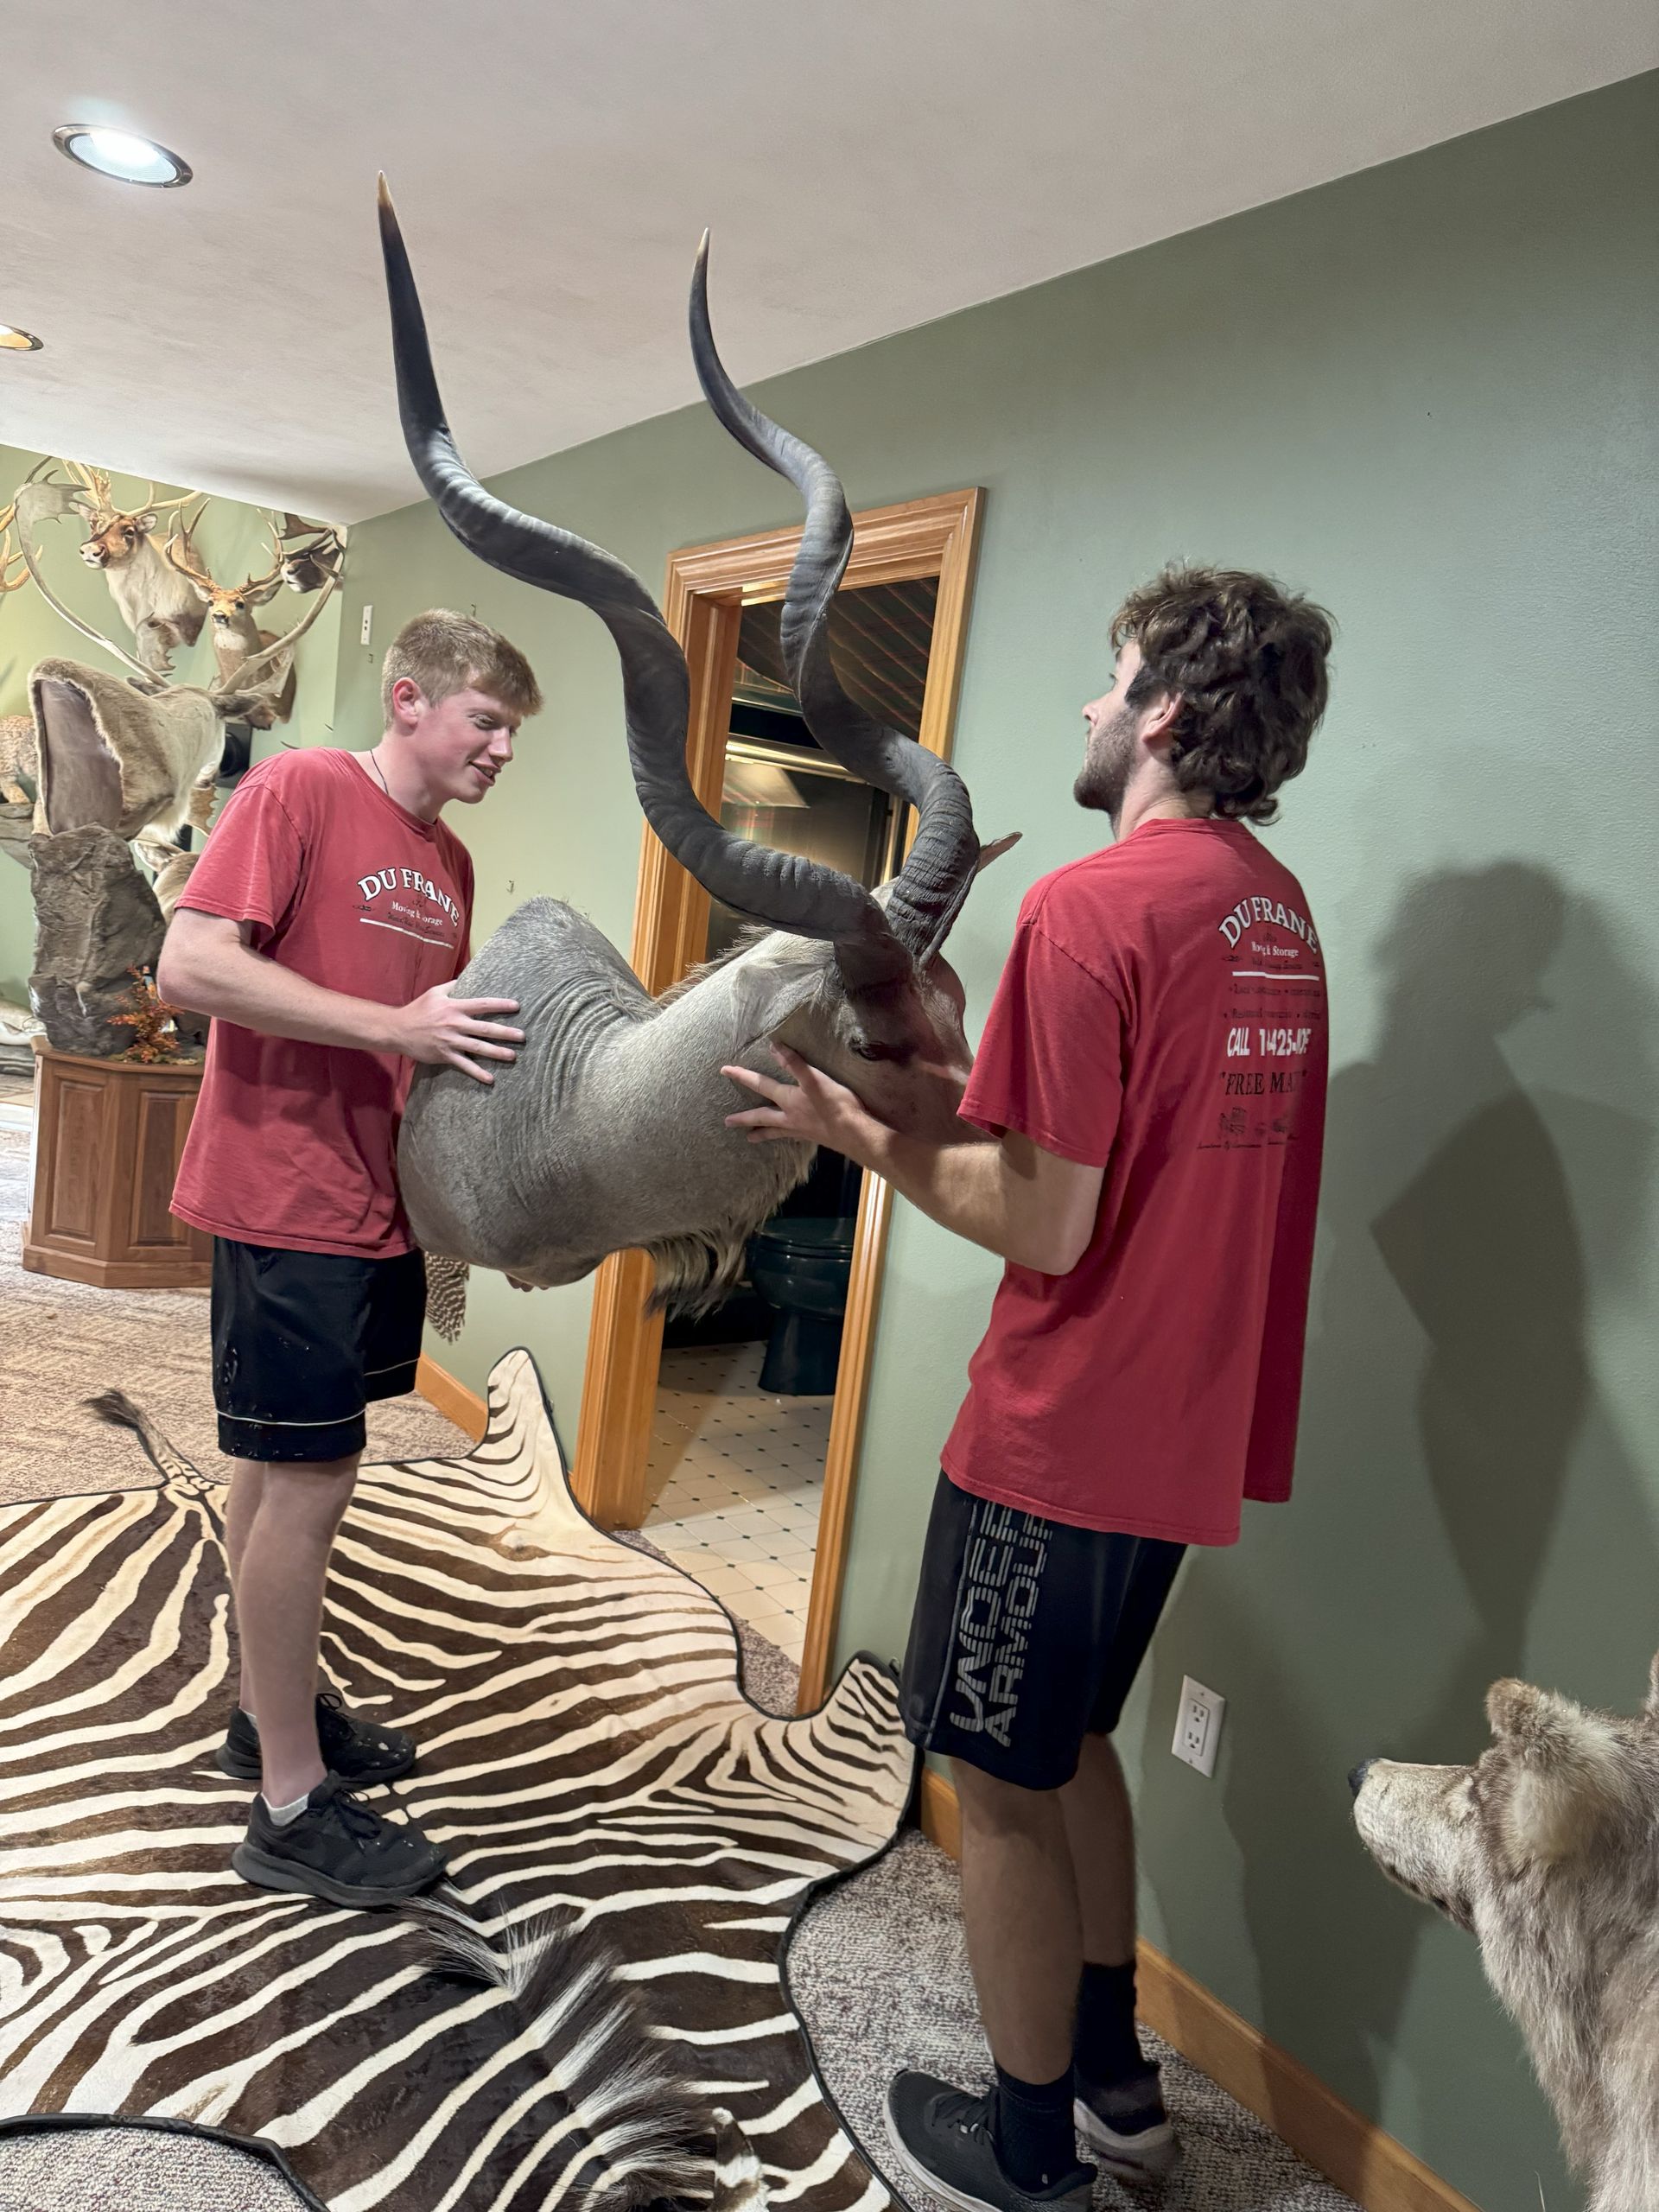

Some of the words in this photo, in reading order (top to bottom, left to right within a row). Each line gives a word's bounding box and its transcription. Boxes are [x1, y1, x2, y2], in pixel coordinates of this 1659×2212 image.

[422, 916, 444, 926] orage
[1272, 944, 1300, 958] Storage
[1227, 1027, 1250, 1057] CALL
